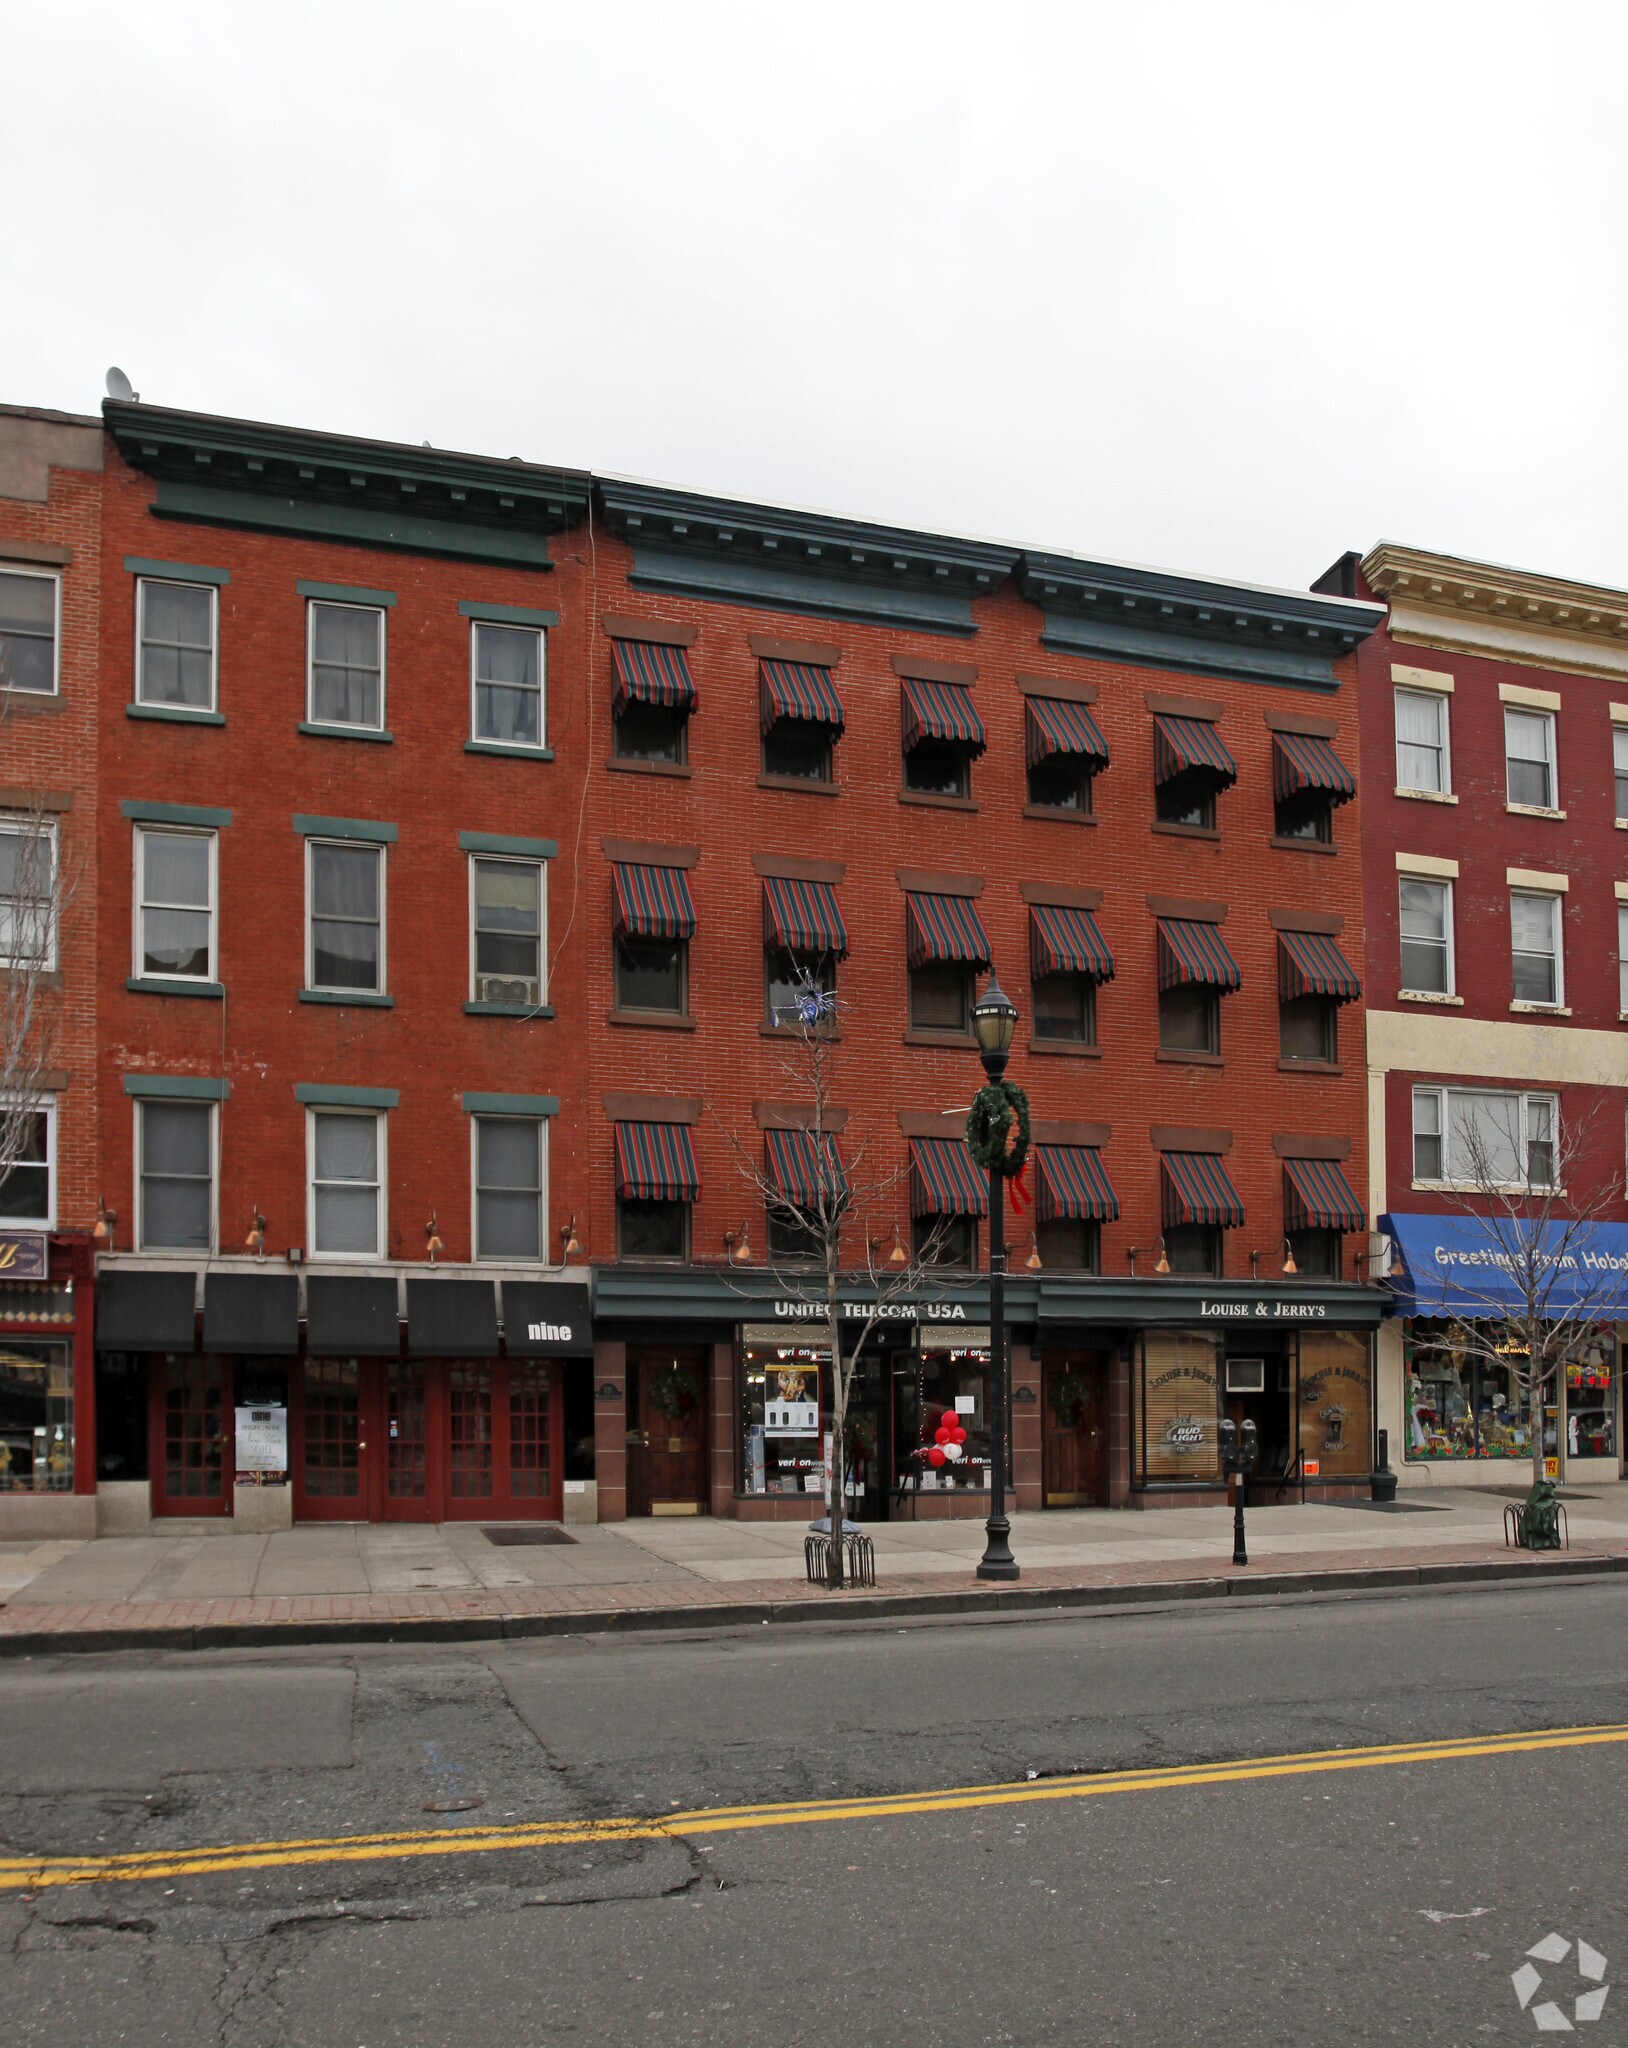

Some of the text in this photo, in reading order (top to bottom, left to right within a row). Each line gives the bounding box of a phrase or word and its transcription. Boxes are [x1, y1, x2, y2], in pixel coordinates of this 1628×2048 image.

[1434, 1246, 1526, 1271] Greetings
[842, 1302, 917, 1318] TELECOM
[927, 1304, 966, 1319] USA
[1200, 1300, 1326, 1317] LOUISE & JERRY'S
[527, 1321, 572, 1341] nine
[251, 1411, 271, 1422] nine
[1172, 1434, 1205, 1442] LIGHT
[1177, 1427, 1201, 1435] BUD
